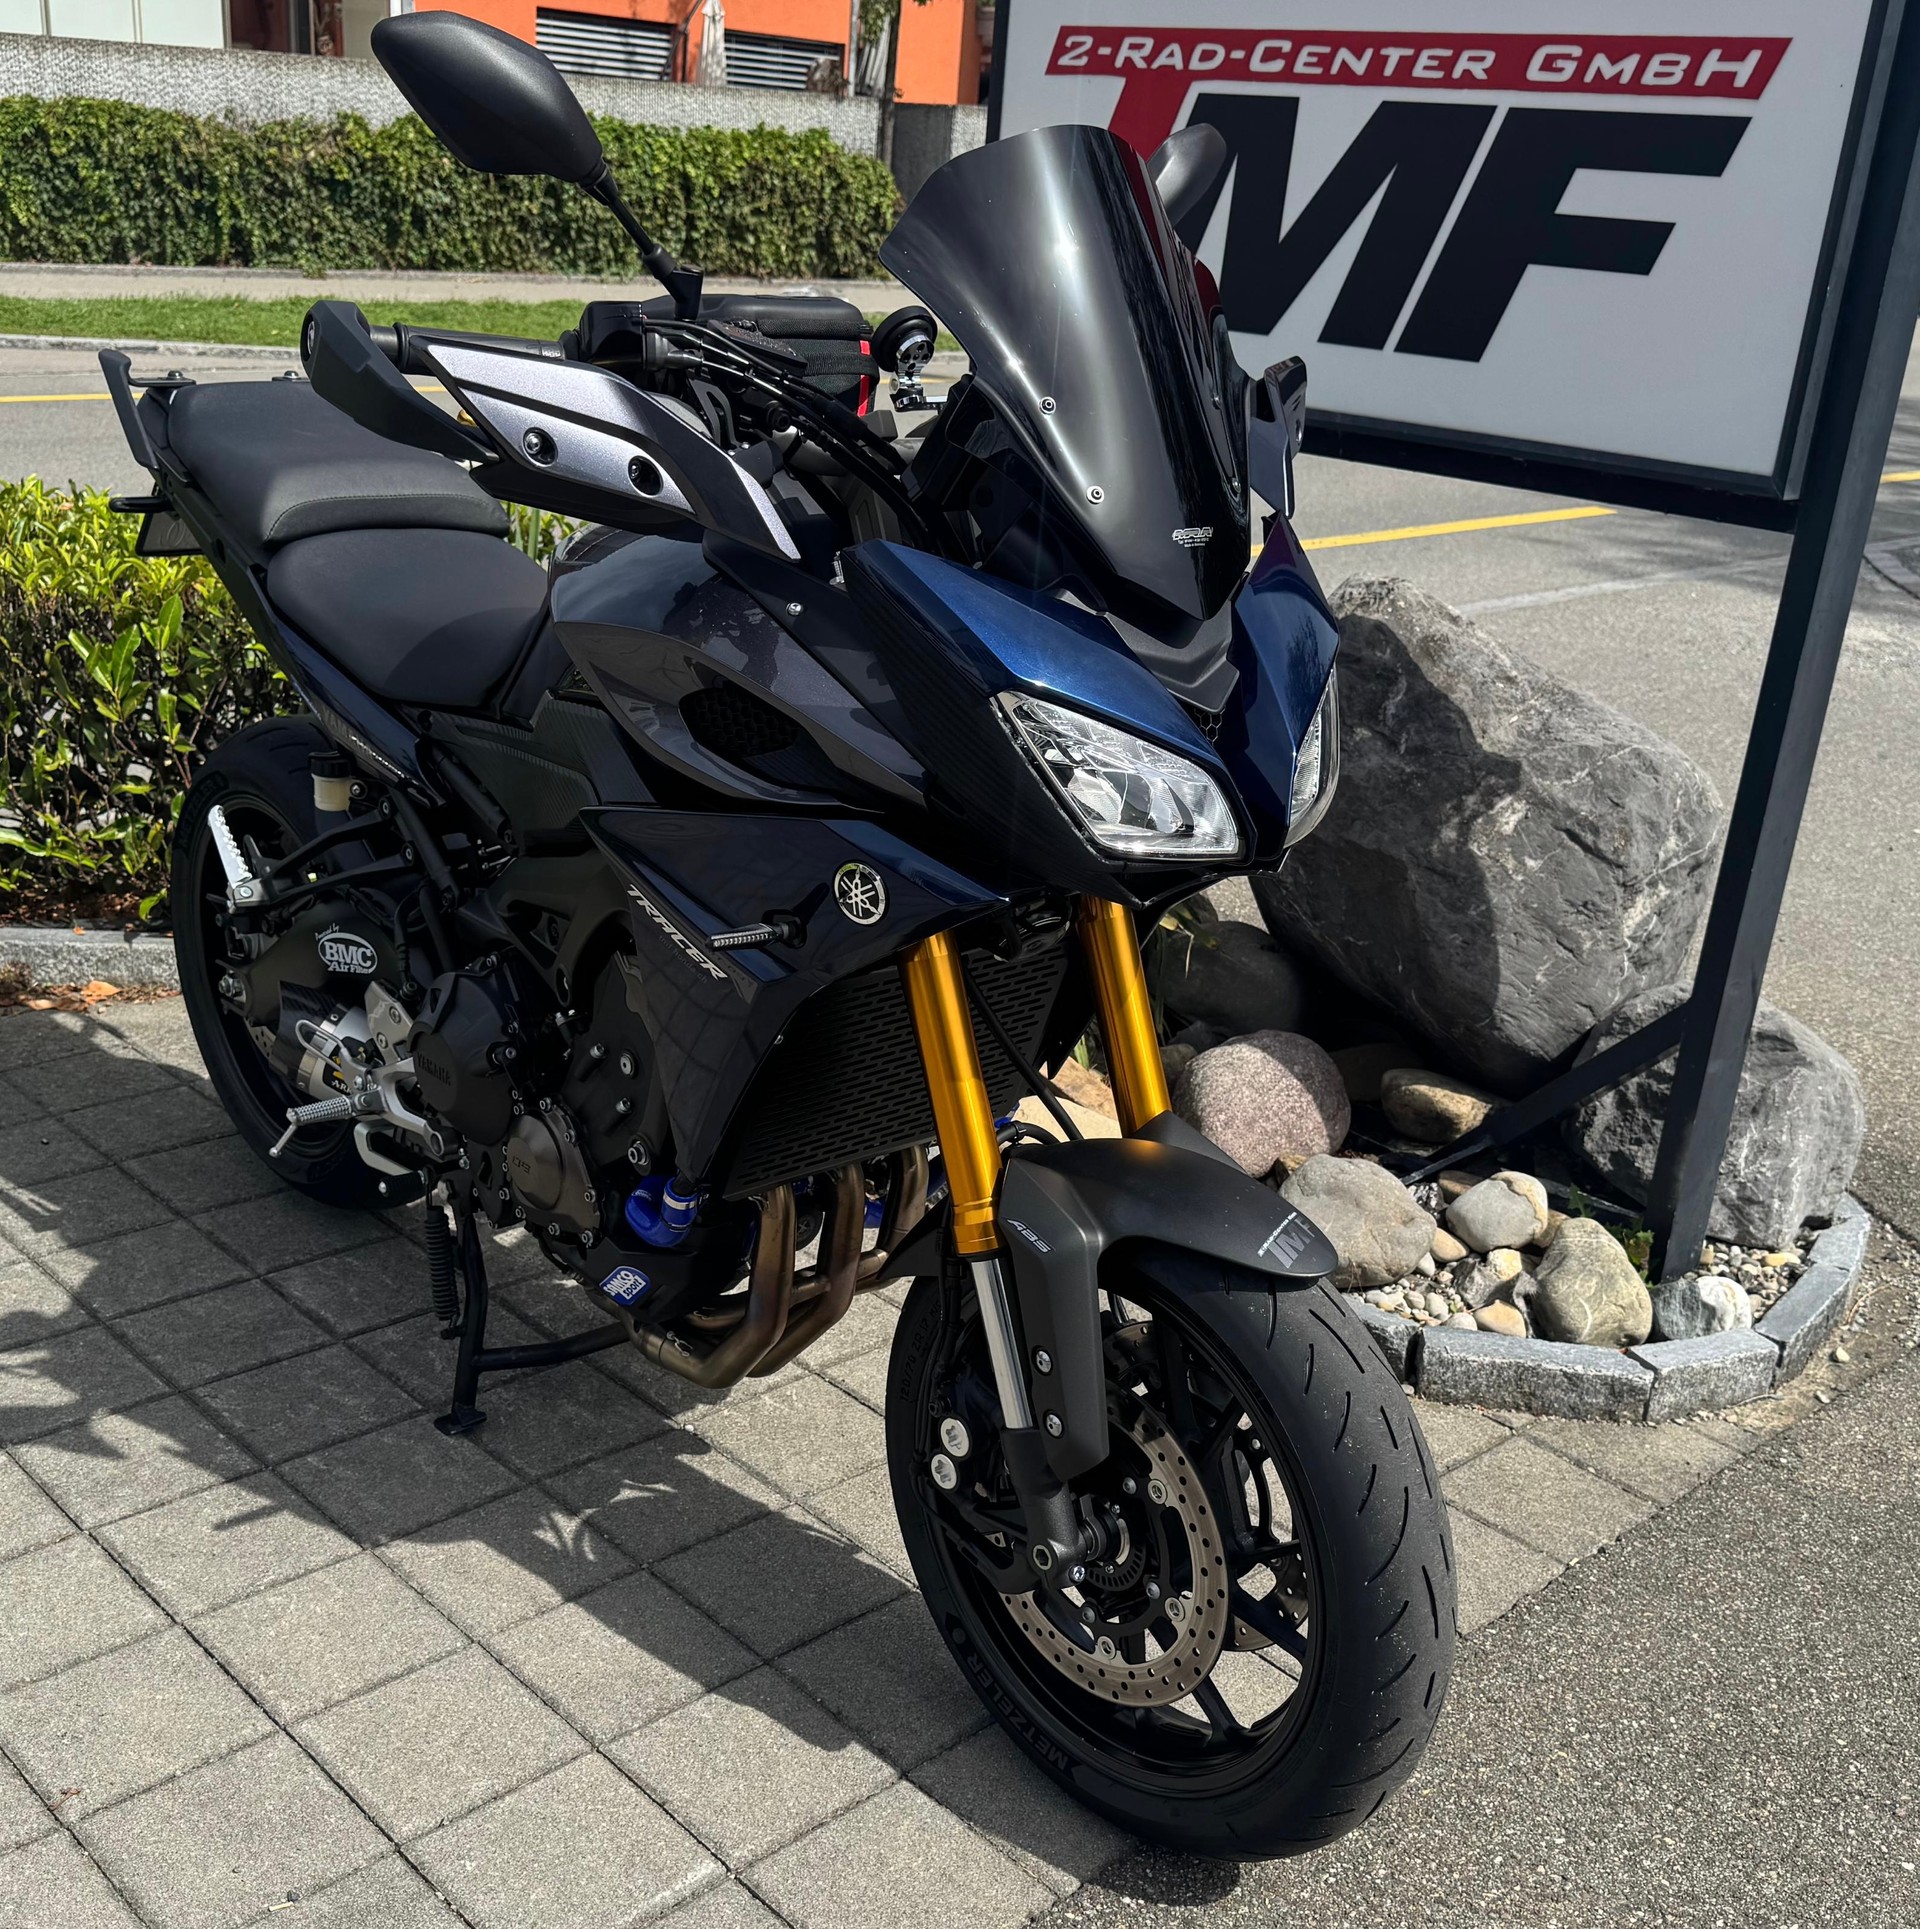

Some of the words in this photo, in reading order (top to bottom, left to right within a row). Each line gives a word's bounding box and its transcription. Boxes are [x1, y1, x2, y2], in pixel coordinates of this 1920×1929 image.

[627, 883, 729, 981] TRACER
[323, 941, 372, 968] BMC
[327, 961, 350, 973] Air
[417, 1051, 451, 1088] YAMAHA
[1006, 1218, 1052, 1253] ABS
[603, 1270, 634, 1296] SAMCO
[966, 1652, 1070, 1771] METZELER
